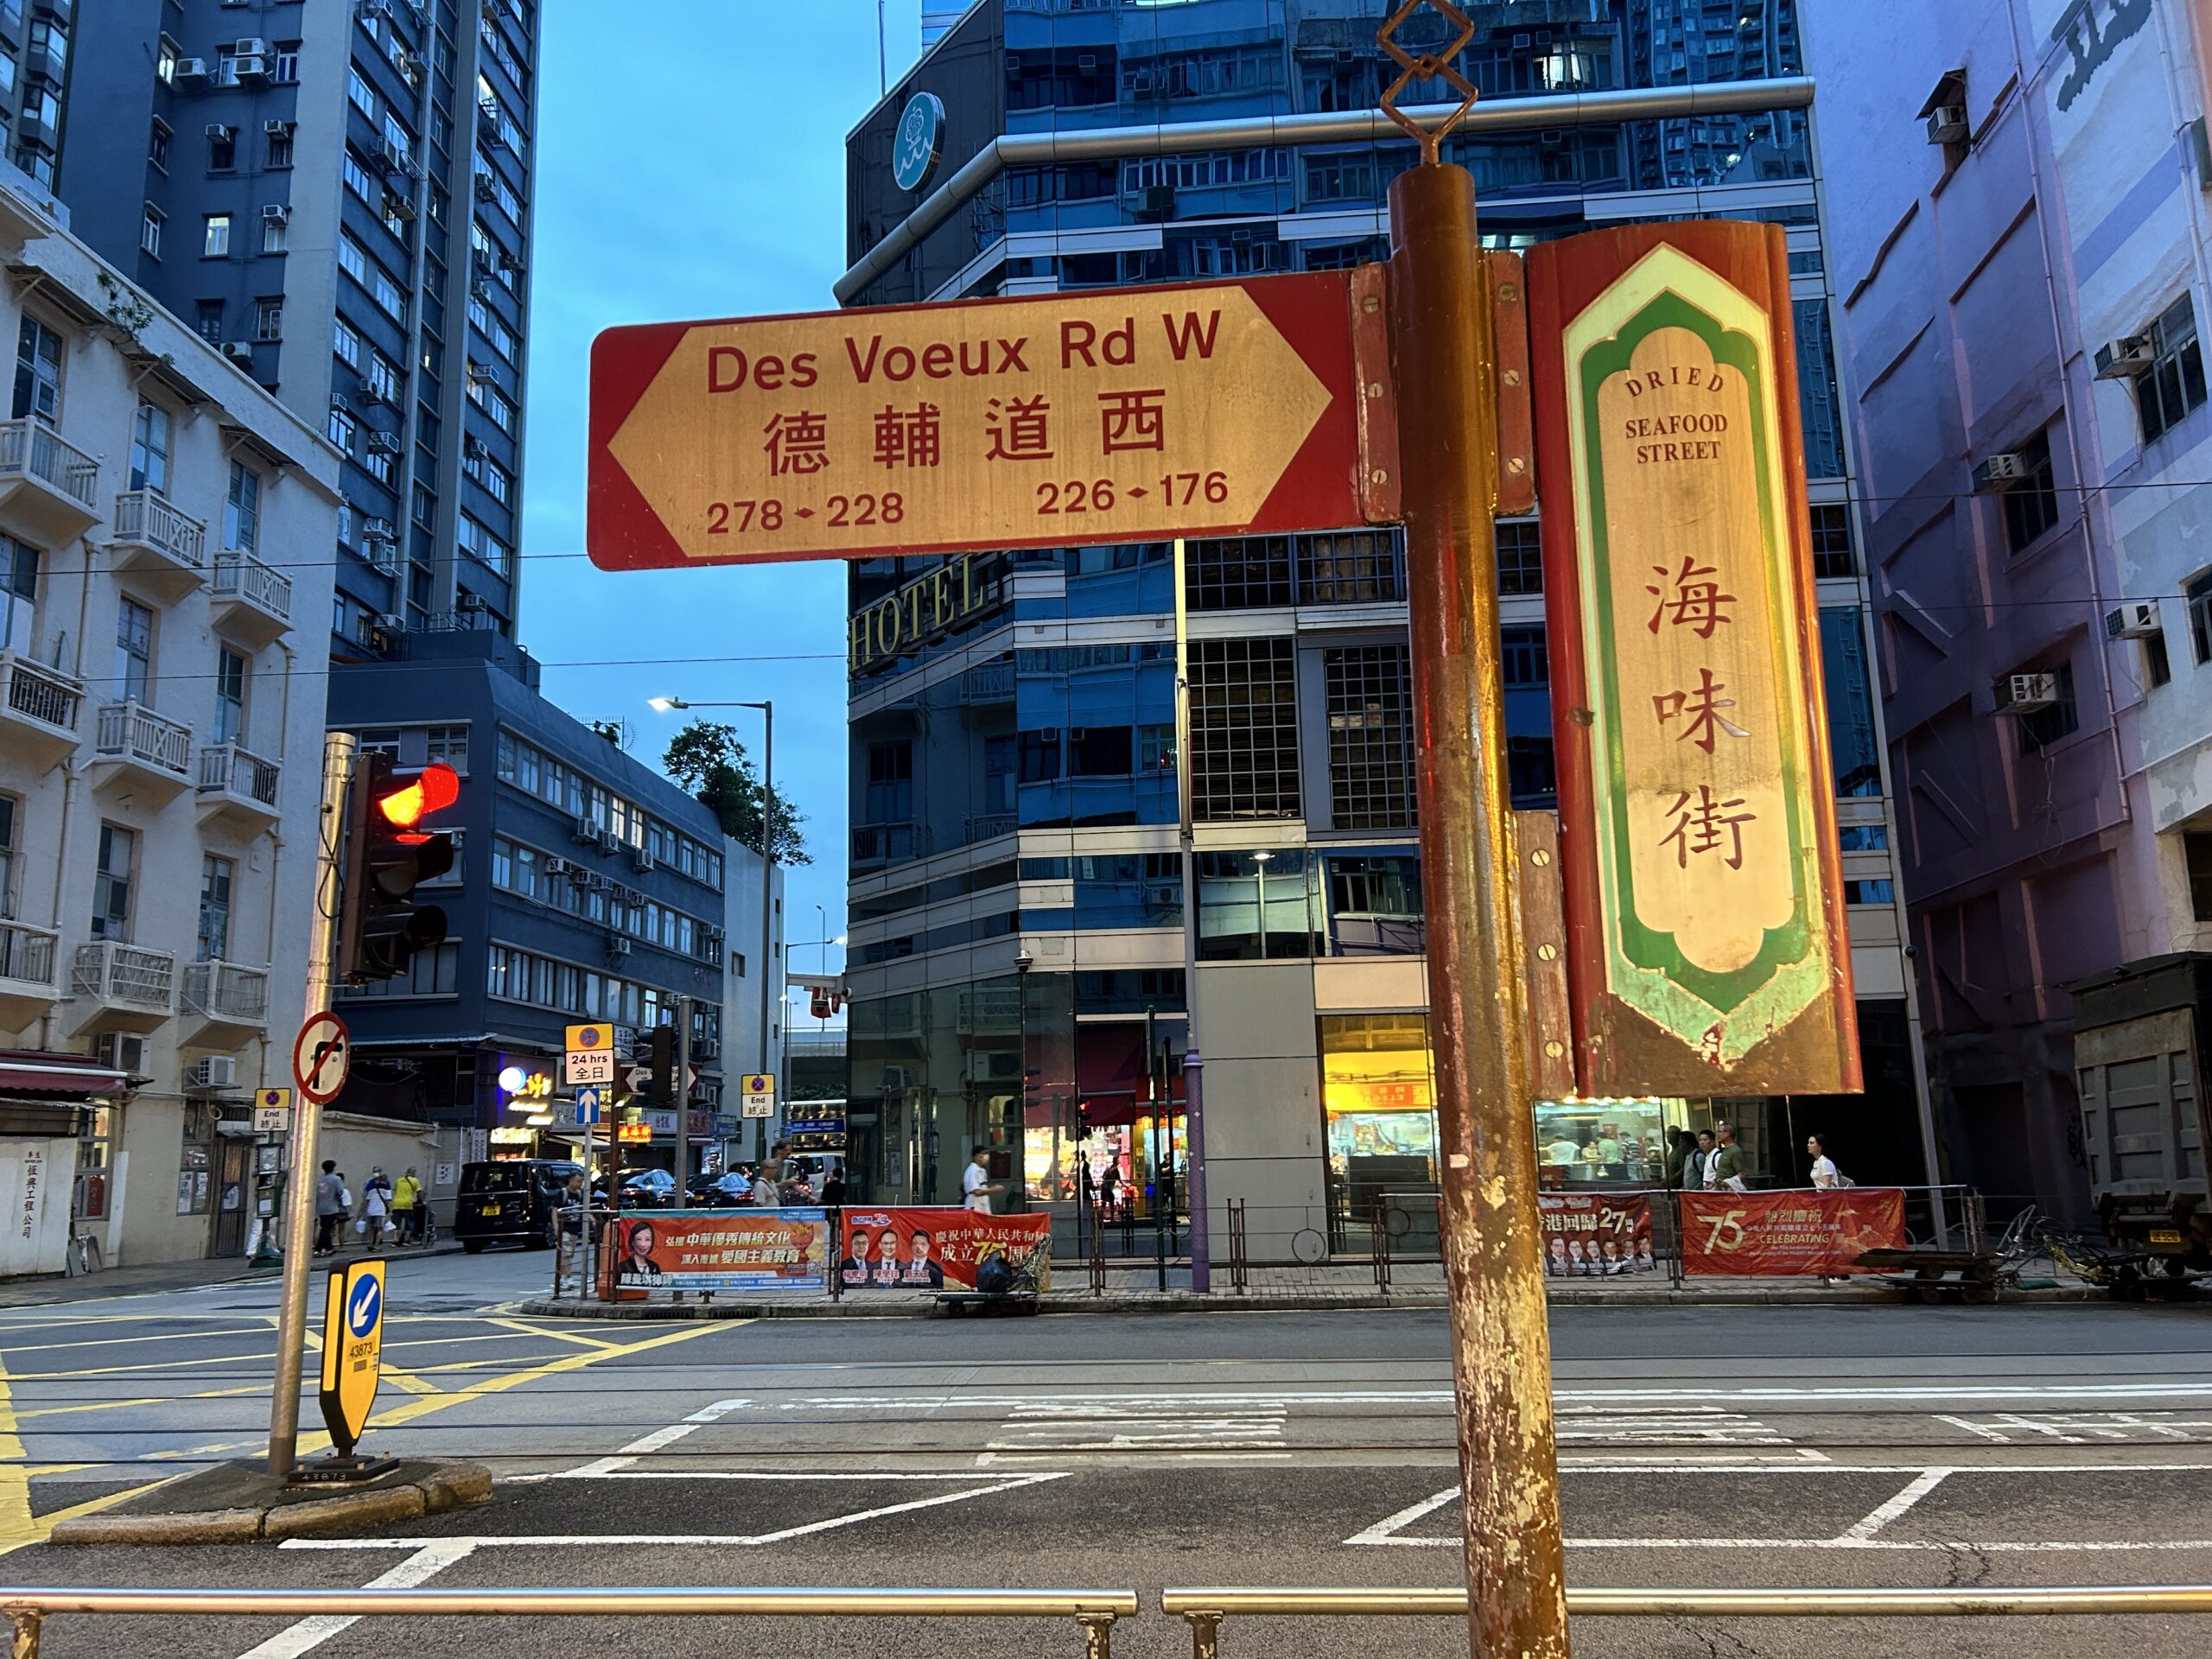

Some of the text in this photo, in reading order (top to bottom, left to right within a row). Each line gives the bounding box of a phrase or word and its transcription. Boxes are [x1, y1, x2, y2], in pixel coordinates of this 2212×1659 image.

[707, 309, 1222, 394] Des Voeux Rd W
[1624, 366, 1725, 397] DRIED
[762, 388, 1166, 477] 德輔道西
[1624, 413, 1728, 440] SEAFOOD
[1637, 441, 1721, 464] STREET
[1036, 471, 1230, 515] 226 176
[707, 492, 904, 533] 278 228
[849, 555, 988, 671] HOTEL
[1645, 556, 1757, 870] 海味街
[571, 1053, 608, 1065] 24 hrs
[575, 1066, 605, 1080] 全日
[1764, 1209, 1822, 1223] 熱烈慶祝
[687, 1231, 791, 1247] 中華優秀傳統文化
[1696, 1210, 1747, 1255] 75
[1759, 1234, 1829, 1243] CELEBRATING
[721, 1249, 800, 1264] 愛國主義教育
[349, 1342, 372, 1358] 43873
